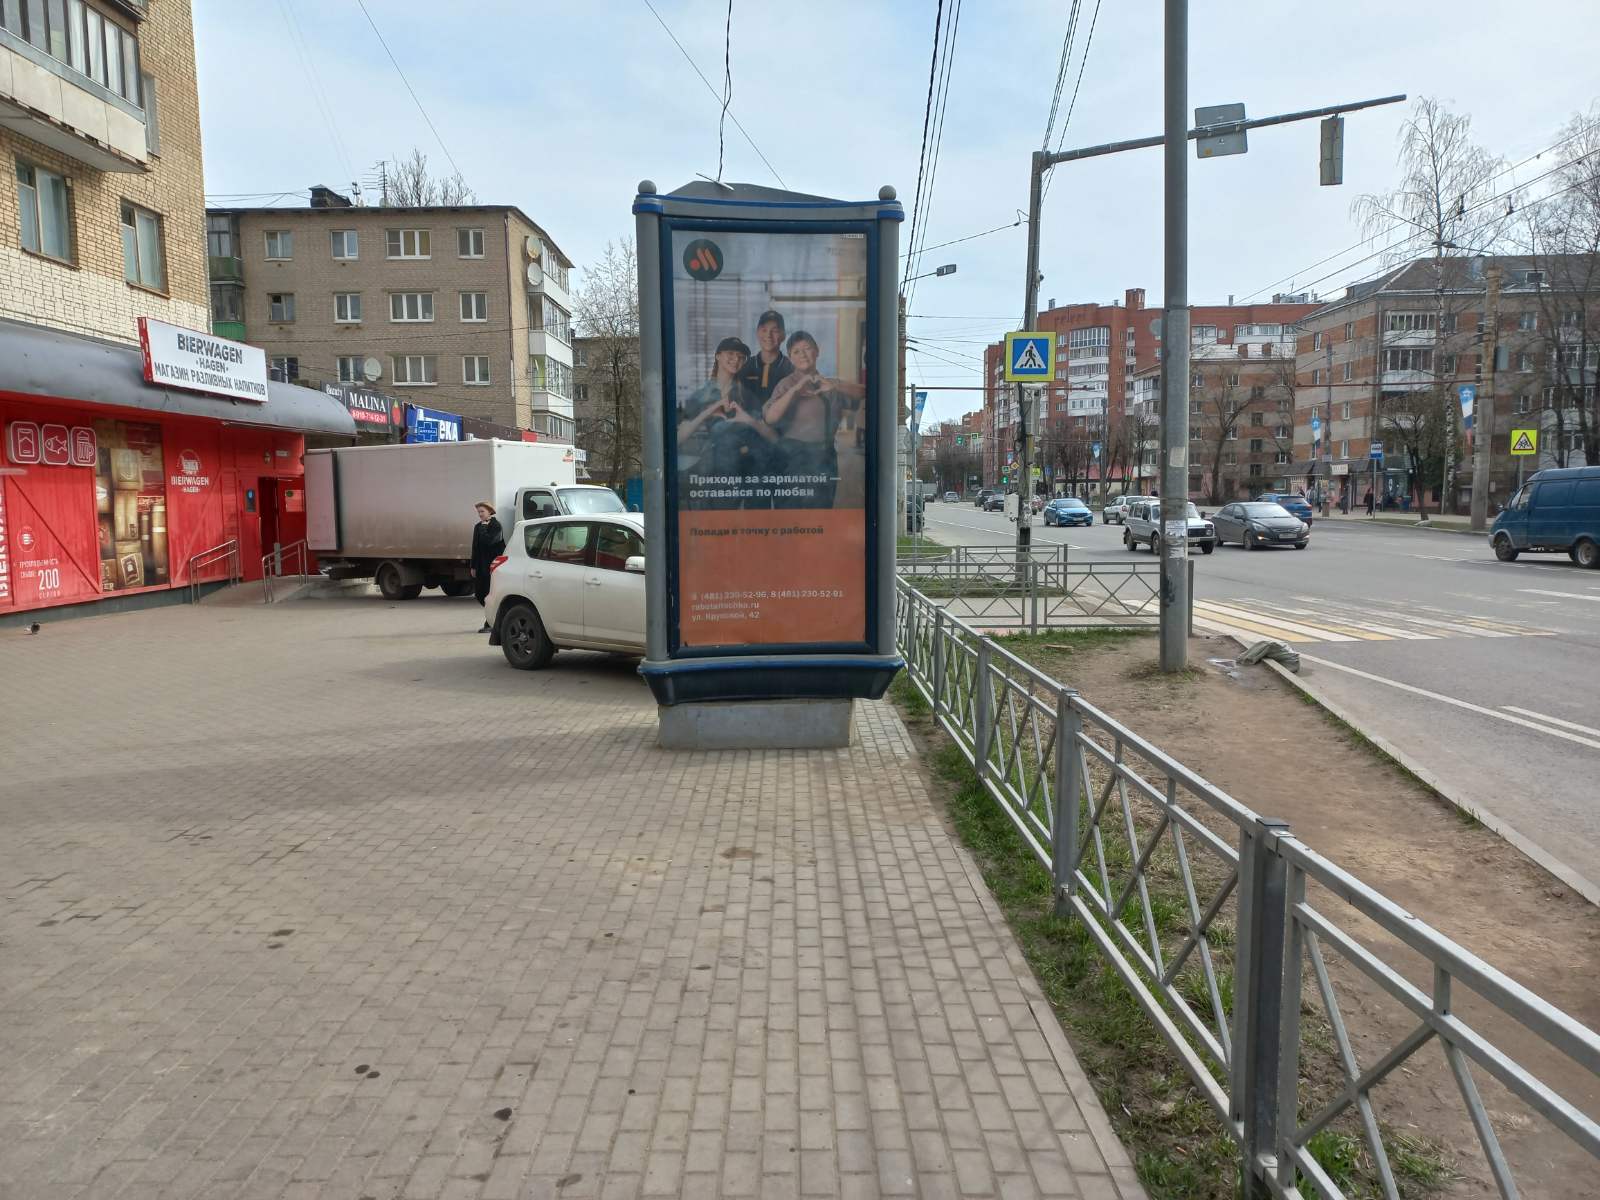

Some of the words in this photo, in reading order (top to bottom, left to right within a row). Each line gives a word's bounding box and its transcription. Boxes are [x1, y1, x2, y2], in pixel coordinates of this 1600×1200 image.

[177, 333, 243, 364] BIERWAGEN
[154, 362, 190, 383] МАГАЗИН
[191, 370, 233, 390] РАЗЛИВНЫХ
[234, 377, 266, 396] НАПИТКОВ
[349, 392, 386, 412] MALINA
[689, 474, 742, 486] Приходи
[745, 476, 759, 484] за
[762, 473, 827, 486] зарплатой
[689, 487, 753, 498] оставайся
[756, 489, 771, 497] по
[774, 487, 814, 498] любви
[690, 527, 730, 537] Попади
[740, 528, 769, 537] точку
[780, 525, 824, 536] работой
[38, 568, 60, 591] 200
[749, 611, 760, 619] 42
